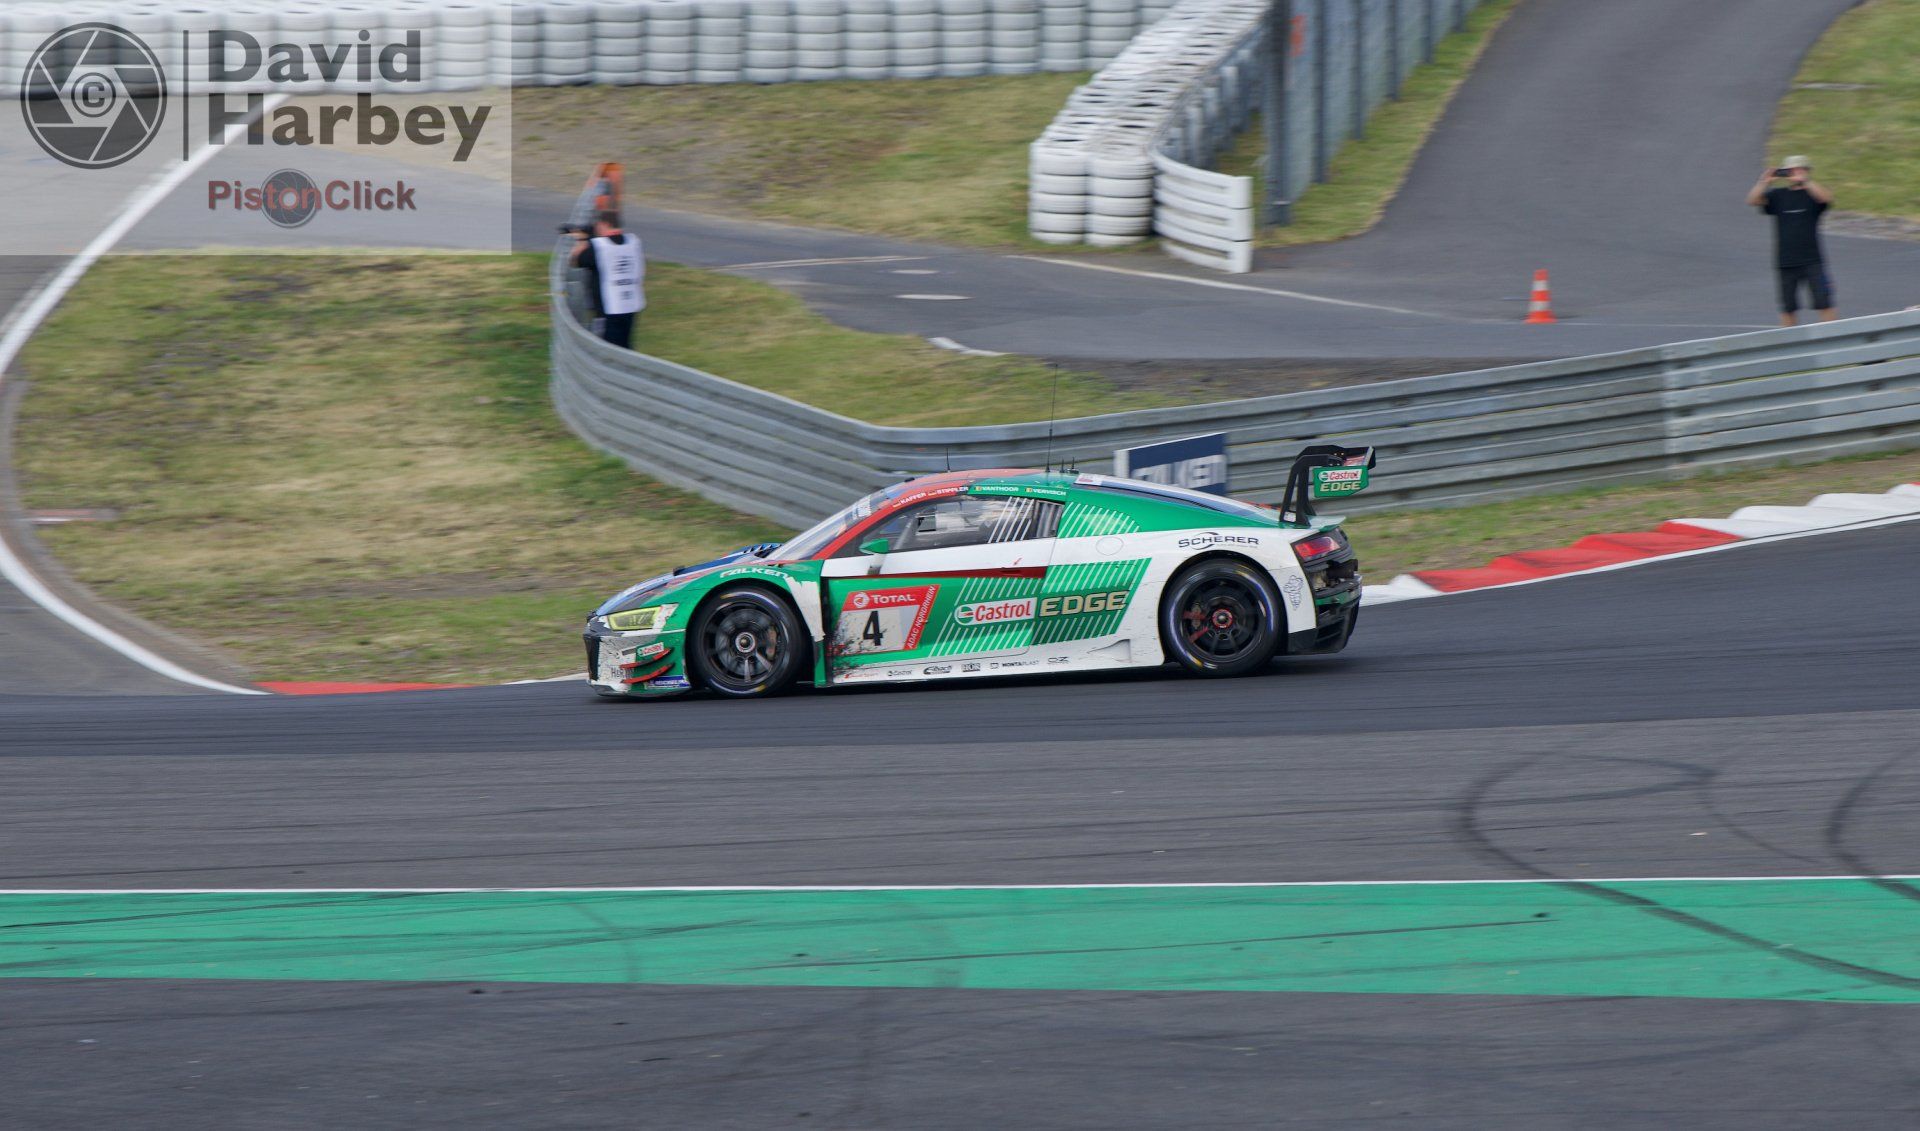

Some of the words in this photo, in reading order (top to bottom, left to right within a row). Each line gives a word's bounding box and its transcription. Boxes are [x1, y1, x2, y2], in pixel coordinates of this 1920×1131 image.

[1329, 470, 1359, 480] Castrol
[1320, 481, 1361, 492] EDGE
[900, 492, 927, 505] KAFFER
[1178, 535, 1260, 548] SCHERER
[720, 567, 788, 579] FALKEN
[871, 593, 916, 604] TOTAL
[975, 600, 1031, 622] Castrol
[1039, 590, 1130, 617] EDGE
[907, 628, 920, 649] ADAC
[915, 585, 936, 628] NORDRHEIN
[863, 611, 883, 646] 4
